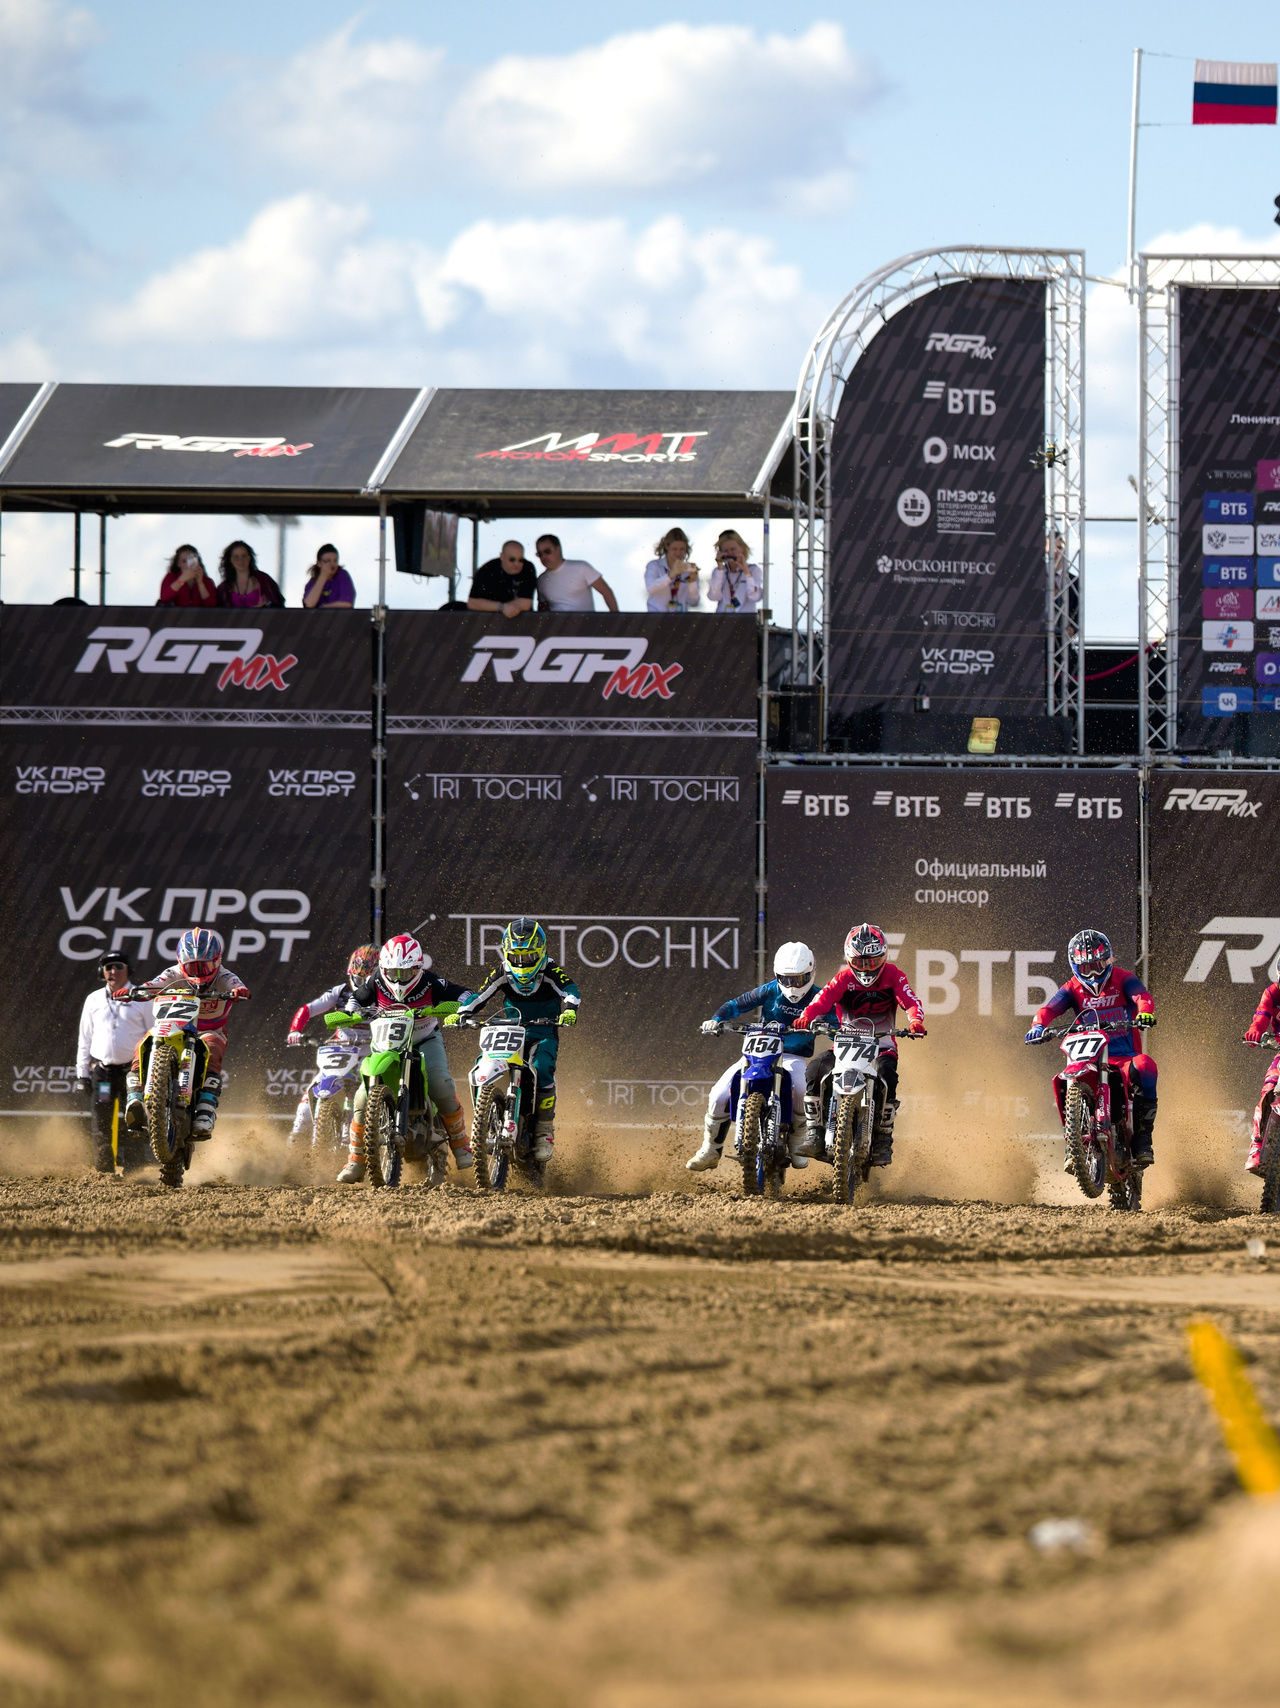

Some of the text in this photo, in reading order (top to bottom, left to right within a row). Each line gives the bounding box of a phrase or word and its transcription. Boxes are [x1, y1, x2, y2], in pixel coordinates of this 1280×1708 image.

[925, 333, 997, 360] RGP MX
[948, 388, 996, 415] ВТБ
[103, 433, 314, 458] RGP MX
[500, 431, 708, 452] MMT
[476, 449, 697, 463] MOTORSPORTS
[1221, 503, 1247, 515] ВТБ
[894, 559, 996, 575] РОСКОНГРЕСС
[1221, 567, 1247, 579] ВТБ
[931, 611, 996, 628] TRI TOCHKI
[75, 627, 299, 691] RGP MX
[921, 648, 995, 662] VK ПРО
[461, 636, 684, 700] RGP MX
[921, 662, 995, 675] СПОРТ
[15, 766, 105, 780] VK ПРО
[142, 769, 232, 783] VK ПРО
[268, 769, 356, 783] VK ПРО
[15, 780, 105, 795] СПОРТ
[141, 782, 231, 798] СПОРТ
[268, 782, 356, 797] СПОРТ
[425, 773, 562, 801] TRI TOCHKI
[603, 775, 739, 802] TRI TOCHKI
[804, 794, 850, 817] ВТБ
[895, 796, 941, 818] ВТБ
[986, 797, 1032, 819] ВТБ
[1077, 797, 1123, 819] ВТБ
[1165, 788, 1262, 818] RGP MX
[915, 858, 1047, 881] Официальный
[59, 887, 311, 923] VK ПРО
[915, 888, 989, 908] спонсор
[547, 925, 740, 970] TOCHKI
[914, 950, 1058, 1017] ВТБ
[156, 1003, 198, 1019] 12
[1082, 994, 1120, 1009] LEATT
[376, 1023, 407, 1043] 113
[480, 1032, 524, 1051] 425
[745, 1038, 780, 1054] 454
[838, 1043, 877, 1062] 774
[1066, 1038, 1103, 1054] 777
[323, 1053, 350, 1070] 3
[13, 1066, 77, 1079] VK ПР
[266, 1069, 297, 1082] VK
[13, 1080, 80, 1093] СПОР
[602, 1080, 634, 1105] TRI
